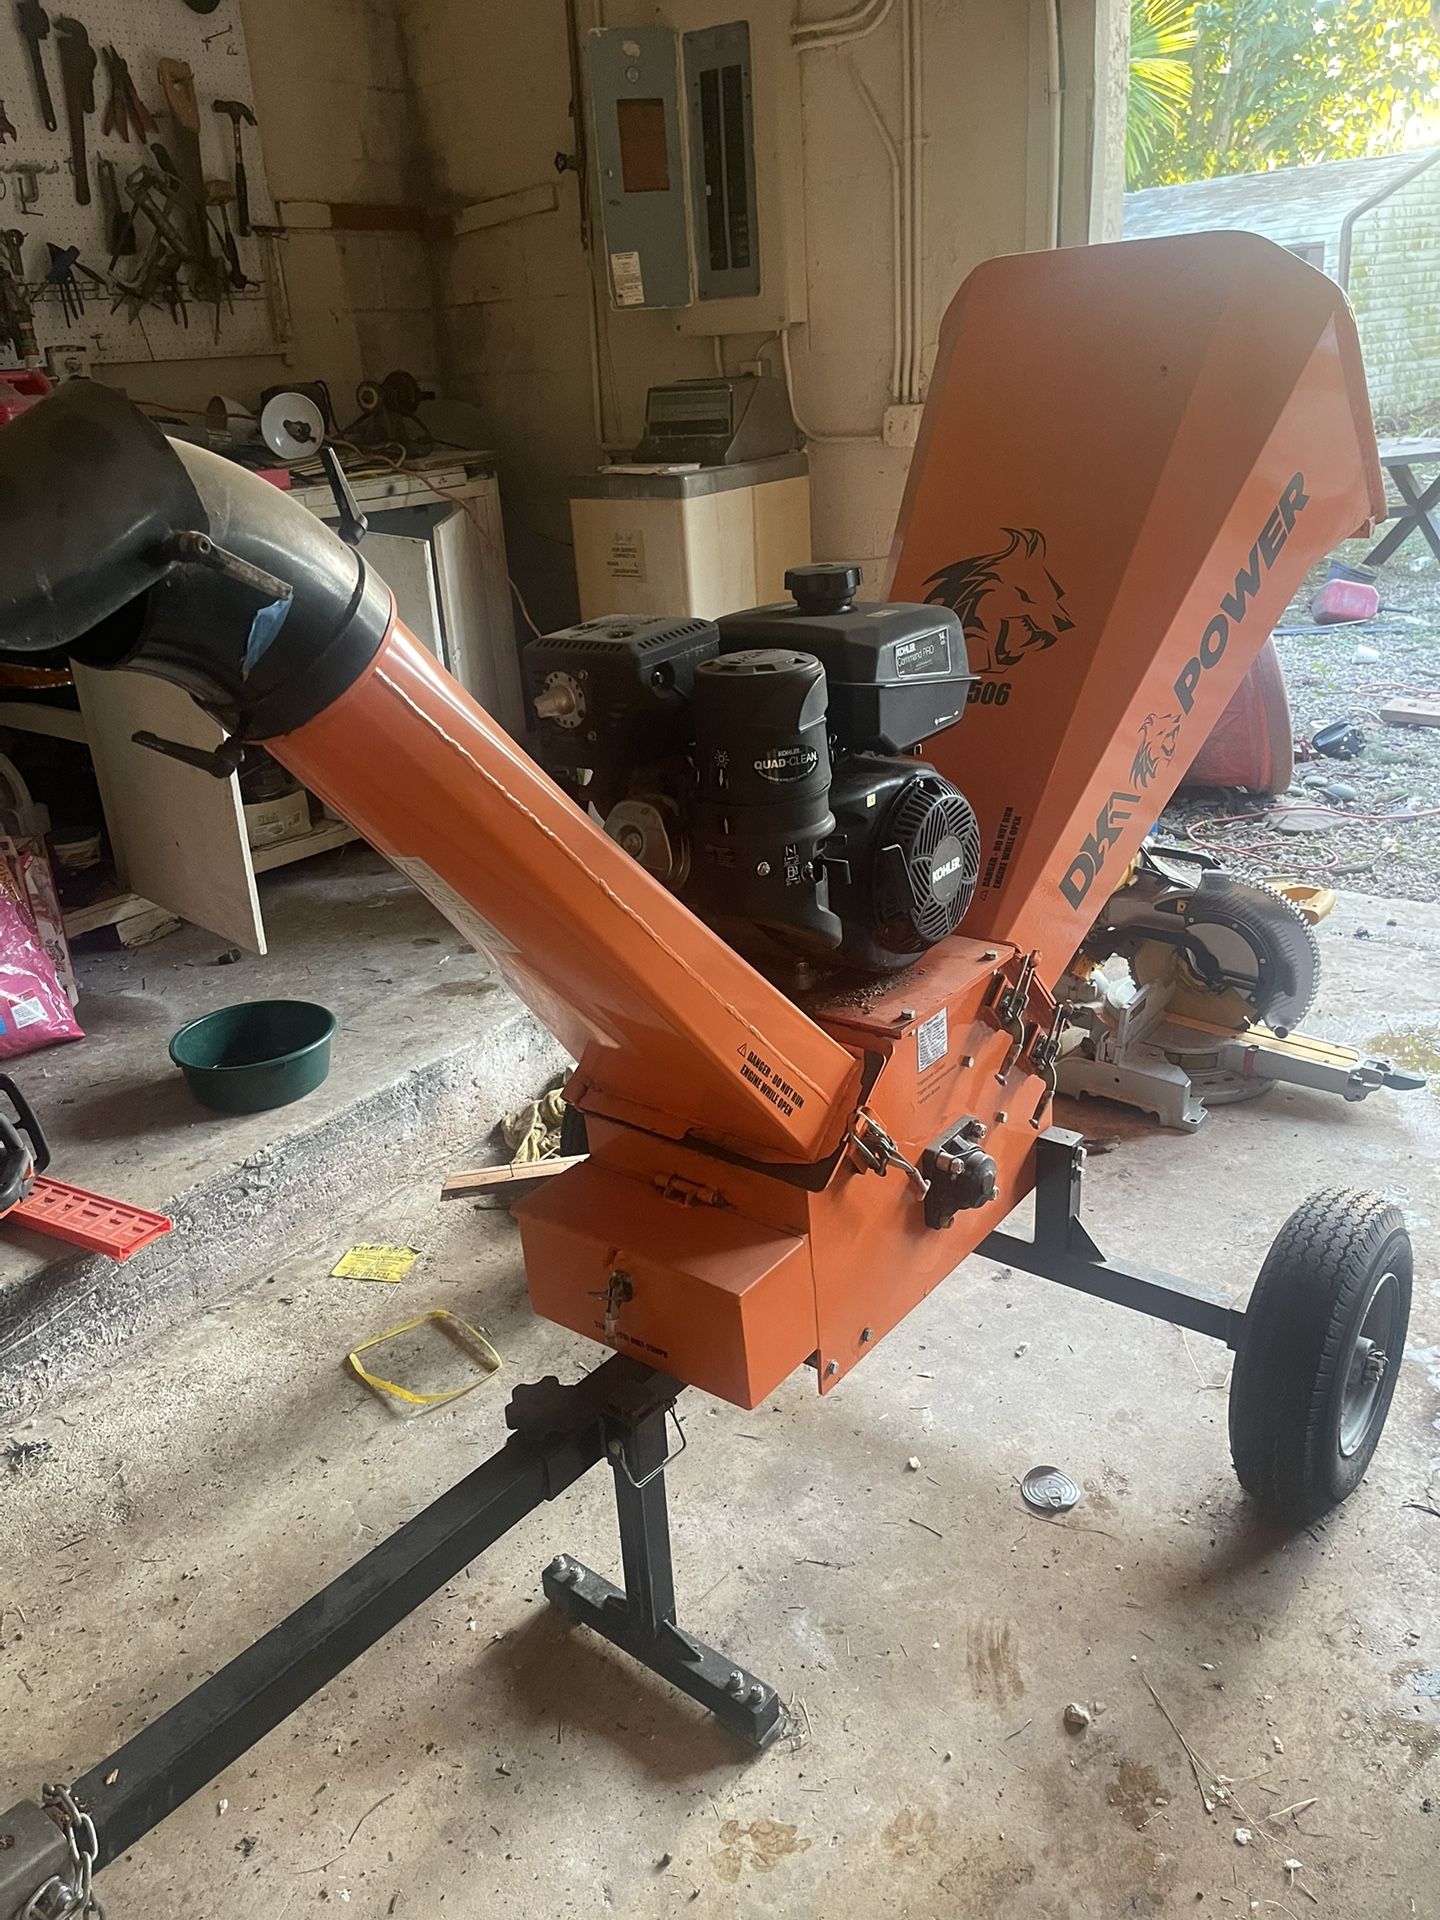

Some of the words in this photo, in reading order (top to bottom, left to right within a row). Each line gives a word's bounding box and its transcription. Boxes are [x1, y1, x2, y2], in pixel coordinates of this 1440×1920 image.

[1174, 471, 1310, 715] POWER
[896, 642, 916, 657] KOHLER
[922, 644, 935, 657] PRO
[754, 751, 818, 771] QUAD-CLEAN
[778, 747, 800, 757] KOHLER
[932, 857, 962, 883] KOHLER
[740, 1064, 762, 1089] ENGINE
[760, 1081, 779, 1105] WHILE
[777, 1098, 794, 1117] OPEN
[746, 1051, 772, 1078] DANGER
[771, 1074, 783, 1088] DO
[780, 1081, 794, 1098] NOT
[790, 1091, 805, 1109] RUN
